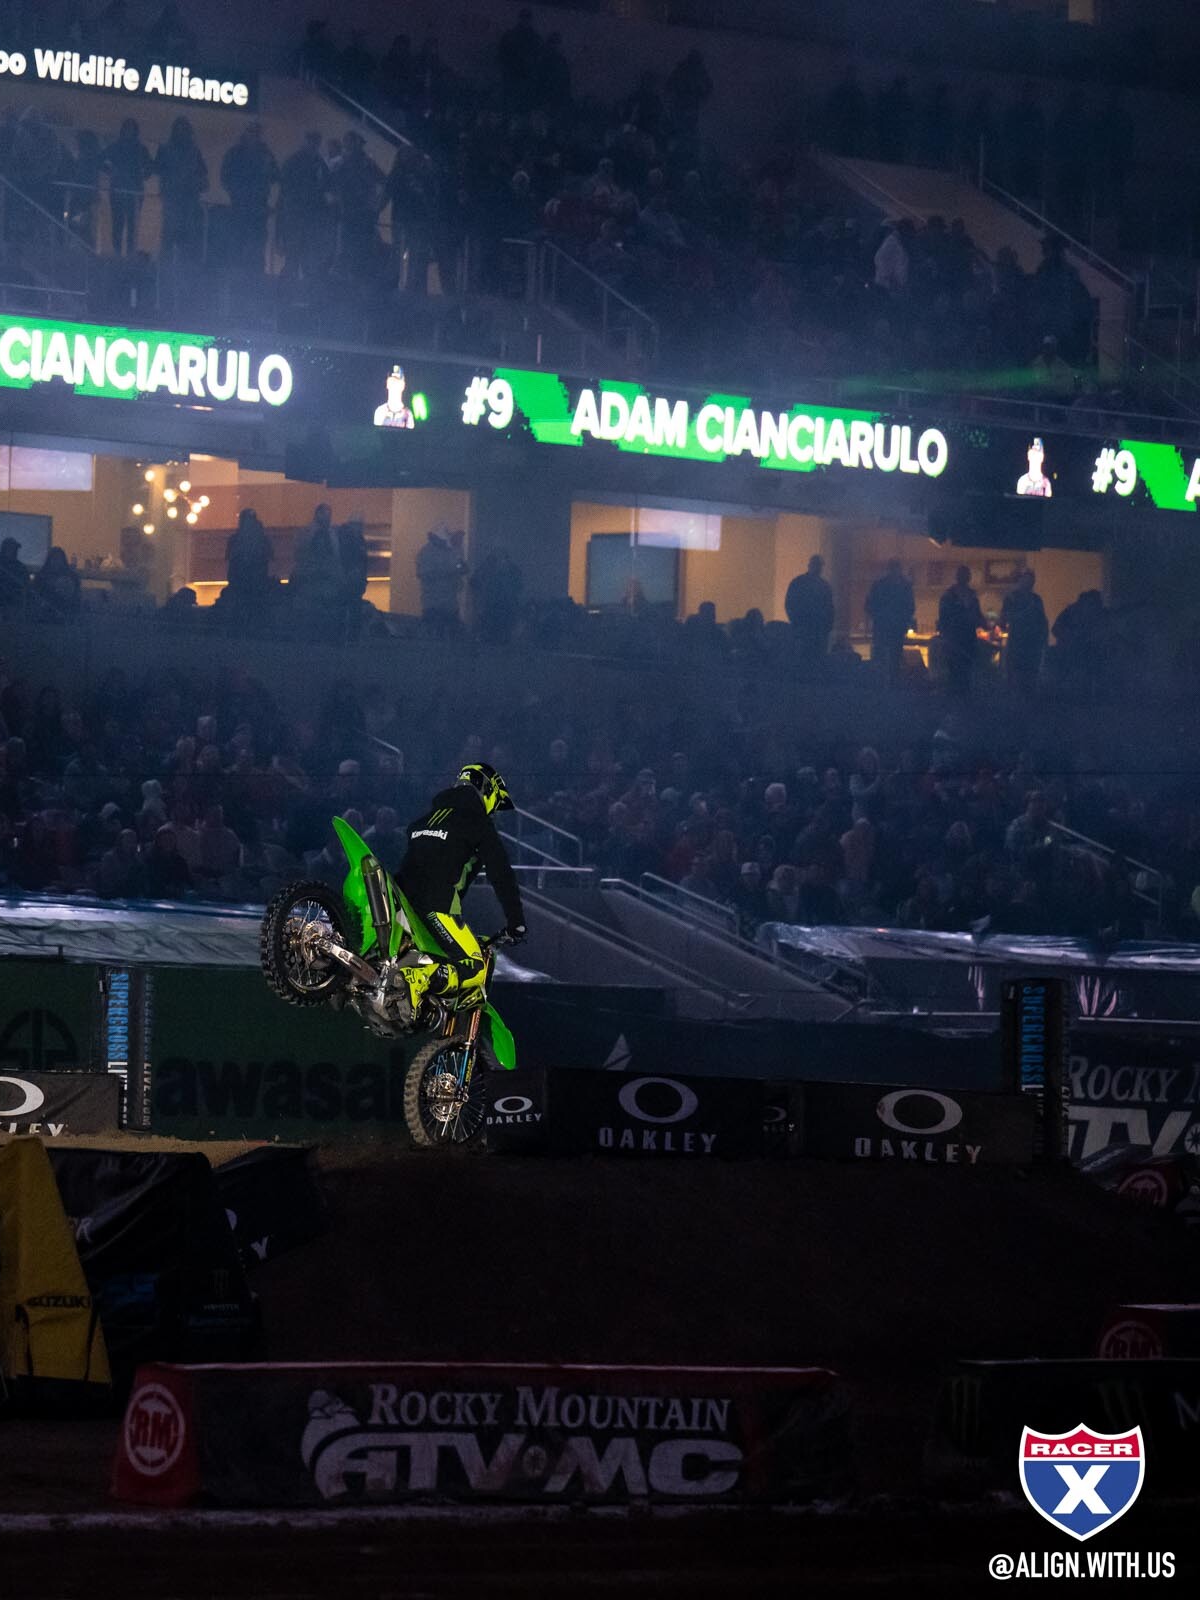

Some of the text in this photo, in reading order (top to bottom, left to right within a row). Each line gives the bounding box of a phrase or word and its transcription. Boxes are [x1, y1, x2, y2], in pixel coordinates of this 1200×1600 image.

[34, 48, 140, 91] Wildlife
[145, 64, 248, 106] Alliance
[0, 326, 293, 406] CIANCIARULO
[461, 376, 948, 478] #9 ADAM CIANCIARULO
[1091, 447, 1138, 497] #9
[486, 1113, 542, 1125] OAKLEY
[598, 1127, 717, 1153] OAKLEY
[853, 1137, 982, 1165] OAKLEY
[368, 1383, 732, 1432] ROCKY MOUNTAIN
